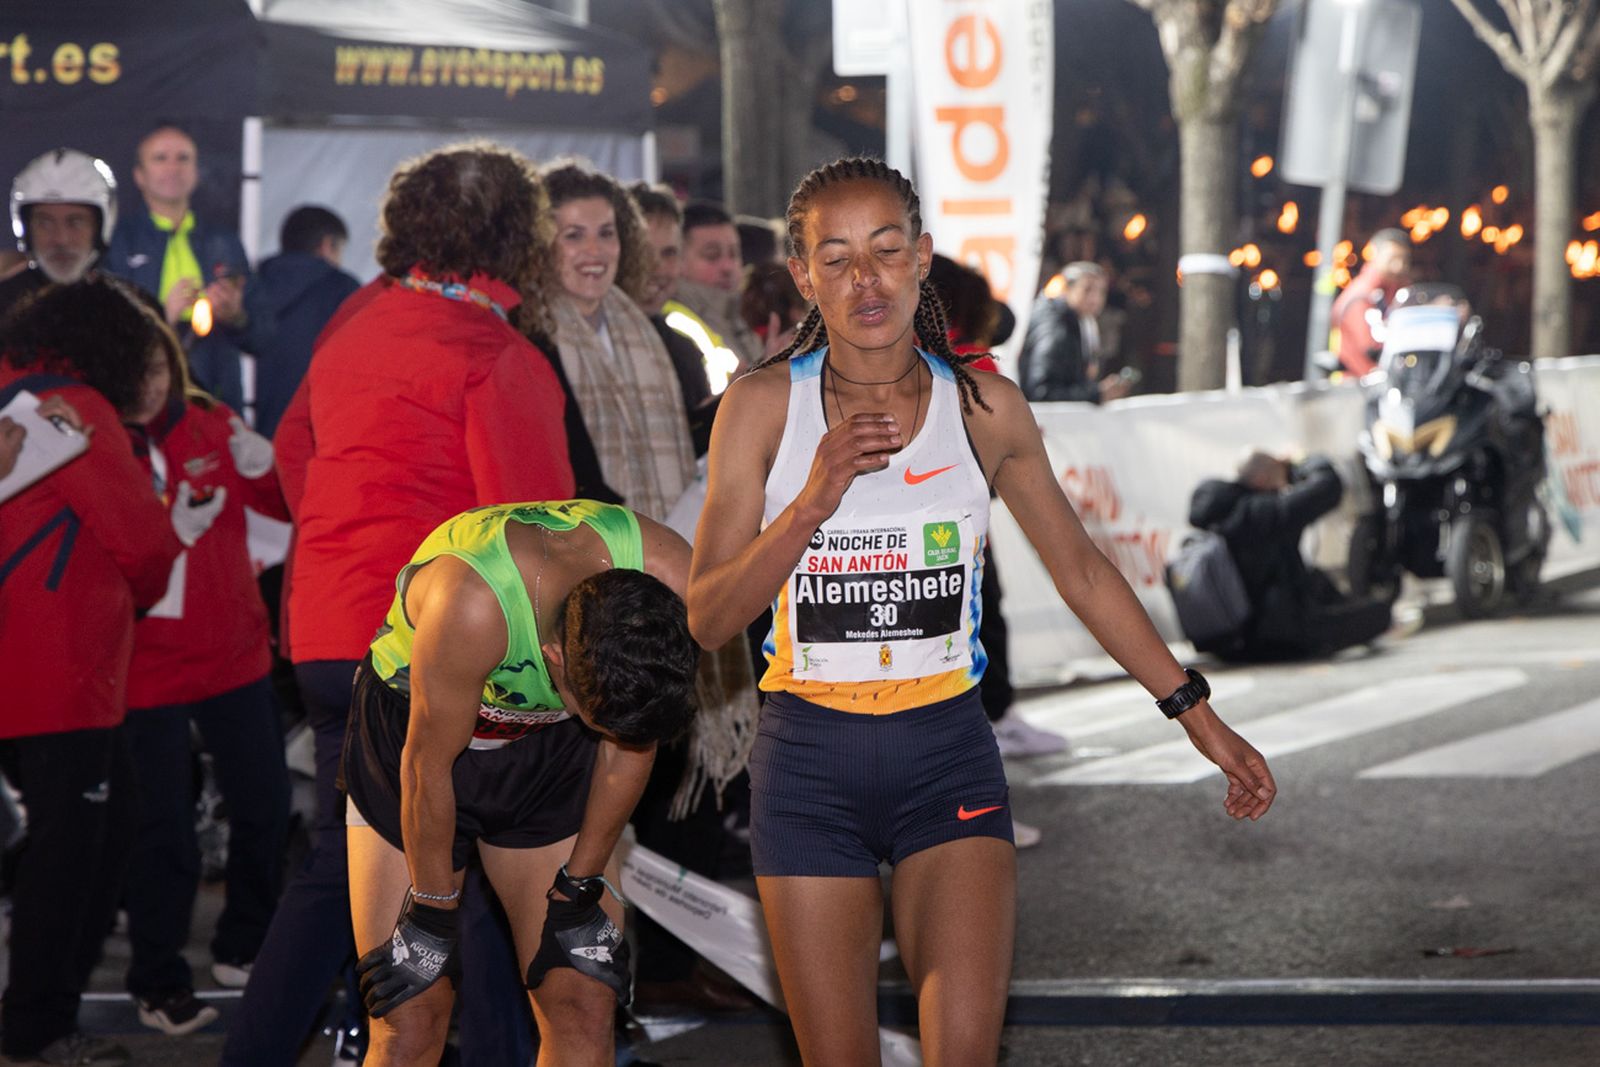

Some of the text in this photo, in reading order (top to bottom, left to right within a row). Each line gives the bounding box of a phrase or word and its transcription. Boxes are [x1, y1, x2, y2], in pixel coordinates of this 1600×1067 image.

[0, 32, 121, 85] t.es
[936, 0, 1016, 303] alde
[828, 533, 907, 551] NOCHE DE
[808, 550, 908, 573] SAN ANTÓN
[797, 571, 962, 604] Alemeshete
[869, 603, 897, 627] 30
[846, 628, 924, 639] Mekedes Alemeshete
[419, 958, 442, 973] SAN
